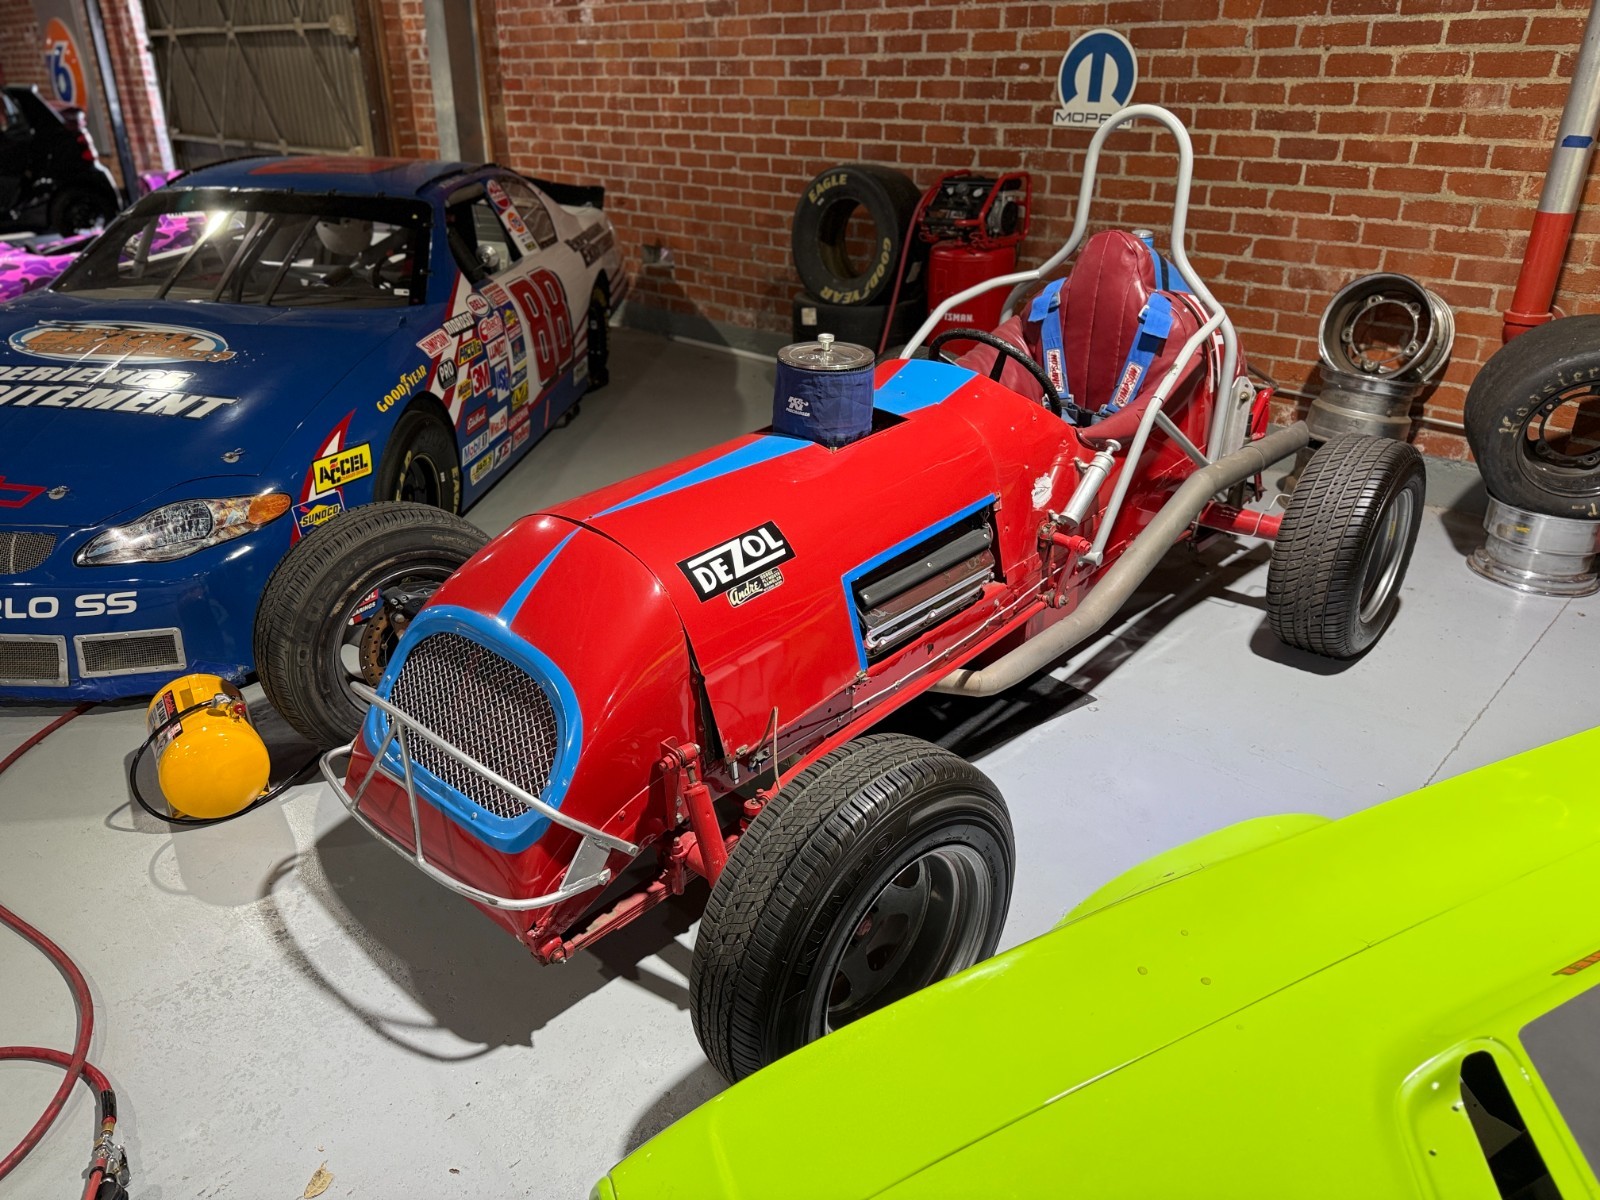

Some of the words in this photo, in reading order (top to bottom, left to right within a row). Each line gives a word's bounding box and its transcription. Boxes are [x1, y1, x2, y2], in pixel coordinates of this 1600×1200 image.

[808, 173, 847, 204] EAGLE
[820, 237, 891, 304] GOODYEAR
[469, 298, 487, 311] BELL
[506, 267, 573, 386] 88
[421, 331, 449, 355] SIMPSON
[439, 361, 454, 382] PRO
[473, 363, 490, 395] 3M
[1117, 367, 1138, 404] SIMPSON
[376, 365, 427, 412] GOODYEAR
[464, 435, 481, 459] Mobil
[320, 453, 368, 484] ACCEL
[301, 504, 340, 527] SUNOCO
[687, 527, 786, 594] DEZOL
[0, 597, 59, 619] LO
[75, 591, 137, 617] SS
